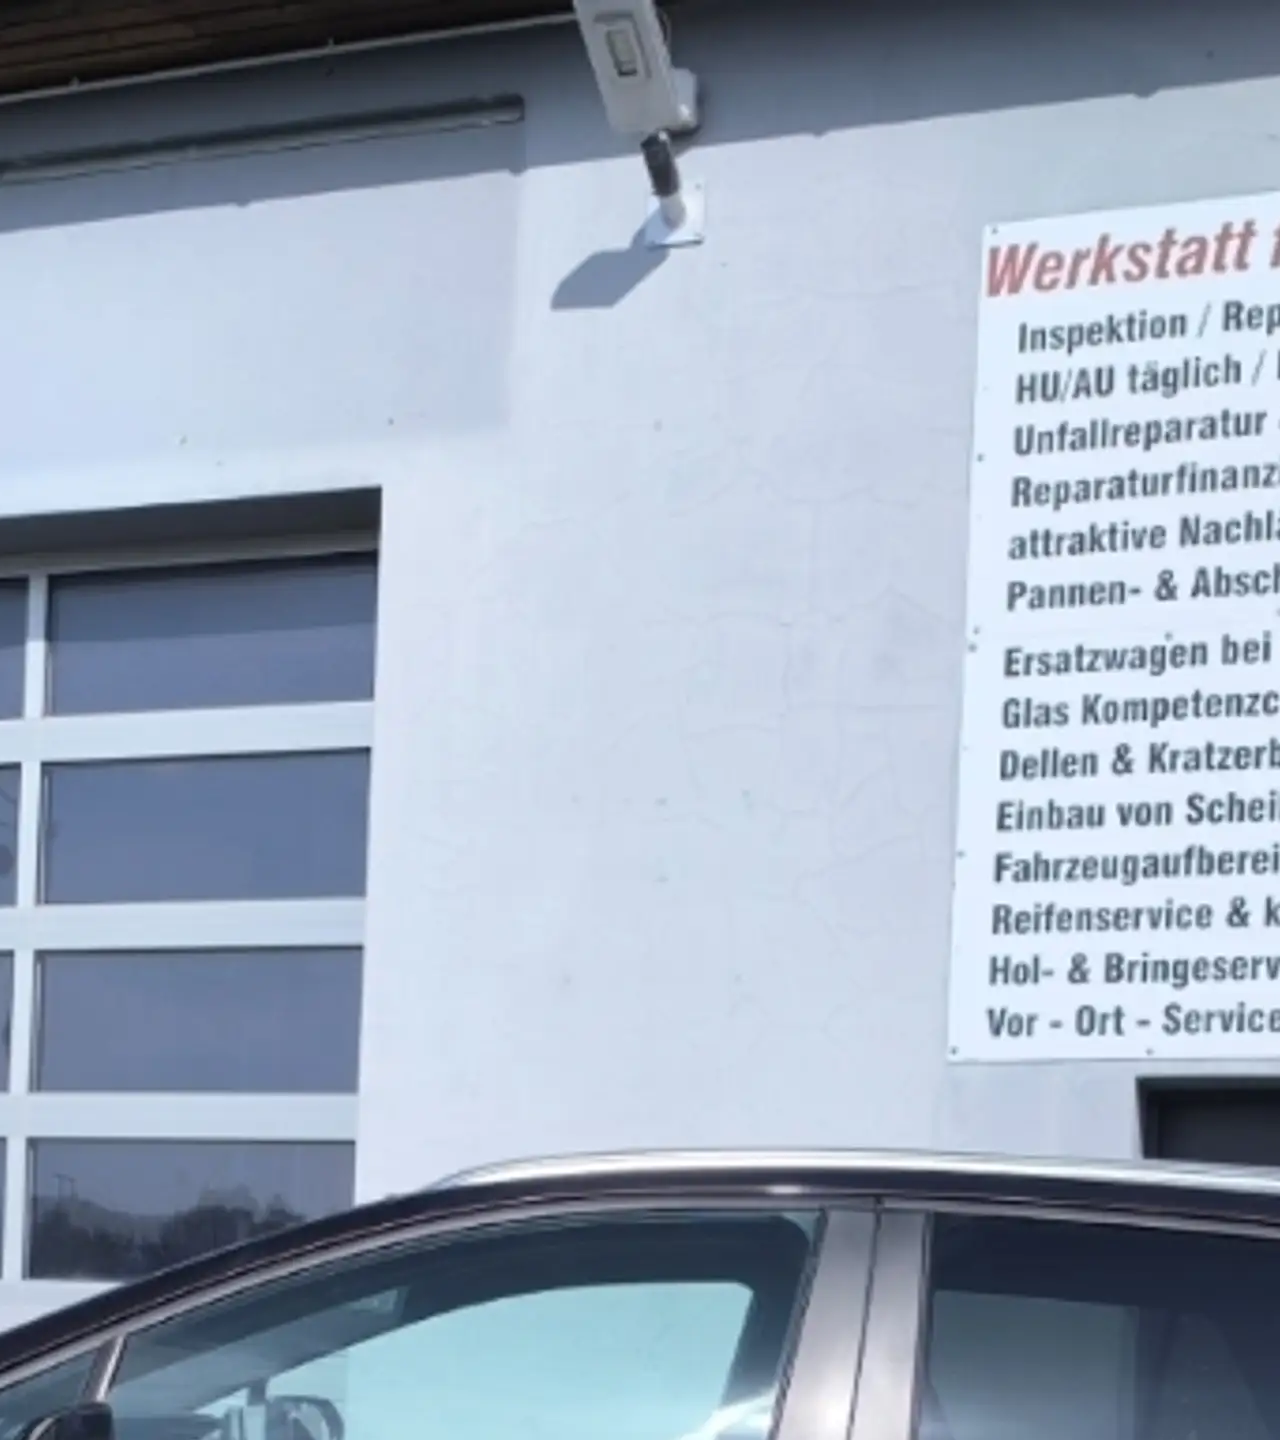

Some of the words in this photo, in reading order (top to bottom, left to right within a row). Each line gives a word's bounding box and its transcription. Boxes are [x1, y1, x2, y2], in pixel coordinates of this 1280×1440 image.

[987, 219, 1257, 297] Werkstatt
[1018, 308, 1188, 357] Inspektion
[1197, 300, 1214, 341] /
[1015, 364, 1116, 405] HU/AU
[1126, 353, 1242, 400] täglich
[1251, 349, 1268, 388] /
[1013, 408, 1268, 457] Unfallreparatur
[1007, 519, 1167, 561] attraktive
[1006, 580, 1142, 613] Pannen-
[1153, 568, 1178, 602] &
[1003, 632, 1209, 679] Ersatzwagen
[1220, 630, 1272, 666] bei
[1001, 696, 1070, 730] Glas
[999, 746, 1099, 782] Dellen
[1110, 742, 1135, 777] &
[995, 798, 1106, 833] Einbau
[1115, 801, 1174, 828] von
[991, 898, 1214, 936] Reifenservice
[1224, 895, 1252, 929] &
[988, 953, 1055, 987] Hol-
[1066, 952, 1091, 985] &
[985, 1007, 1039, 1038] Vor
[1074, 1004, 1126, 1037] Ort
